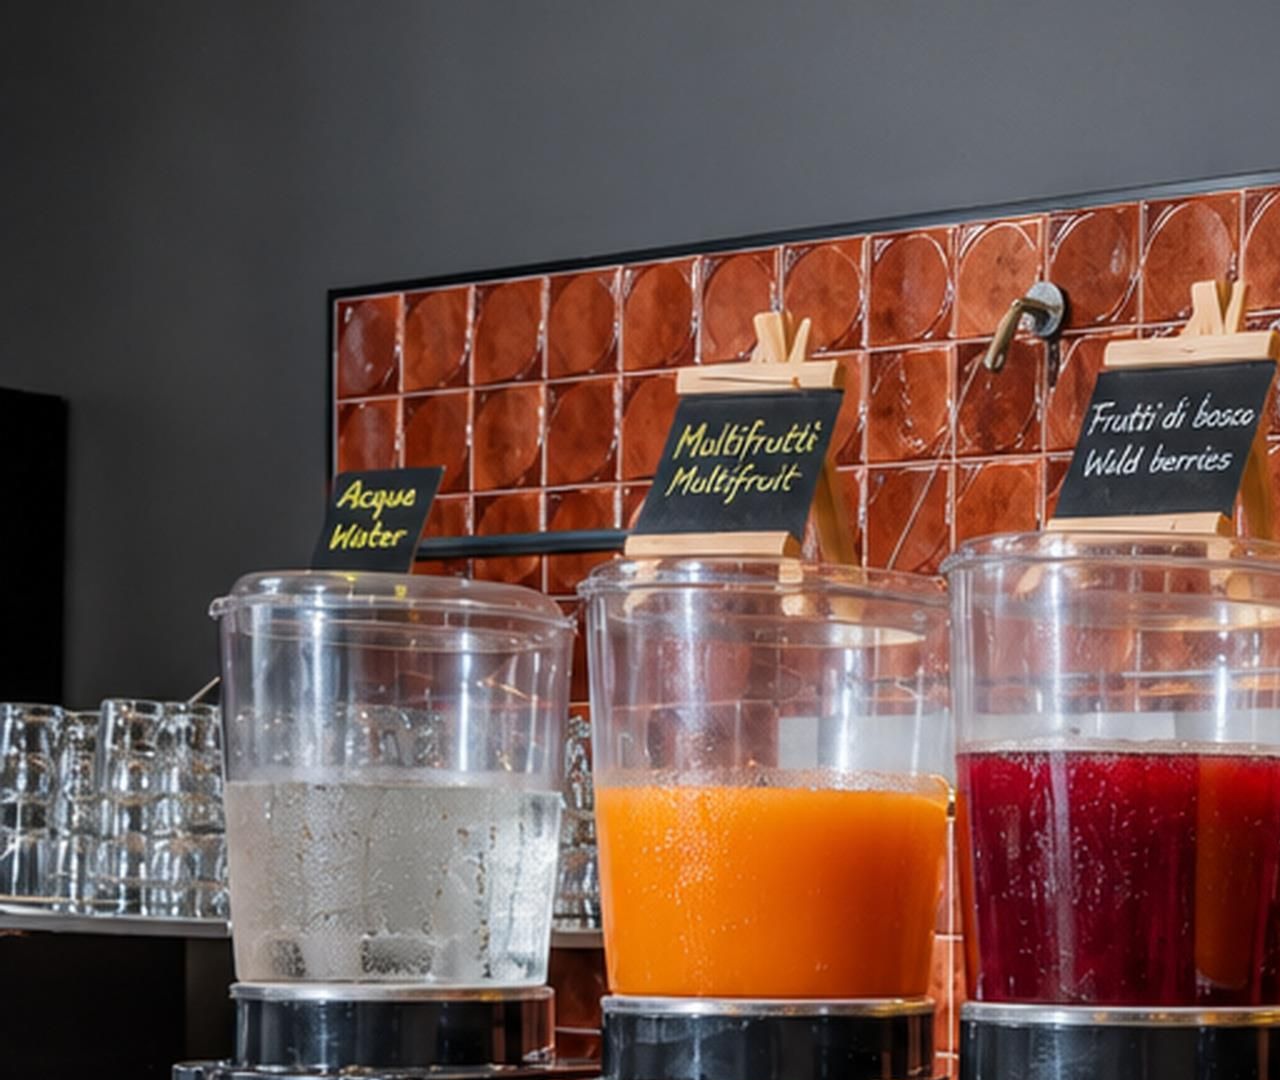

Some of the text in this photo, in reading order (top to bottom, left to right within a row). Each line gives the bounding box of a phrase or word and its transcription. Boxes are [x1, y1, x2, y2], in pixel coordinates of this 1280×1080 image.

[1087, 392, 1255, 436] Frutti di bosco
[1084, 443, 1233, 477] Wild berries
